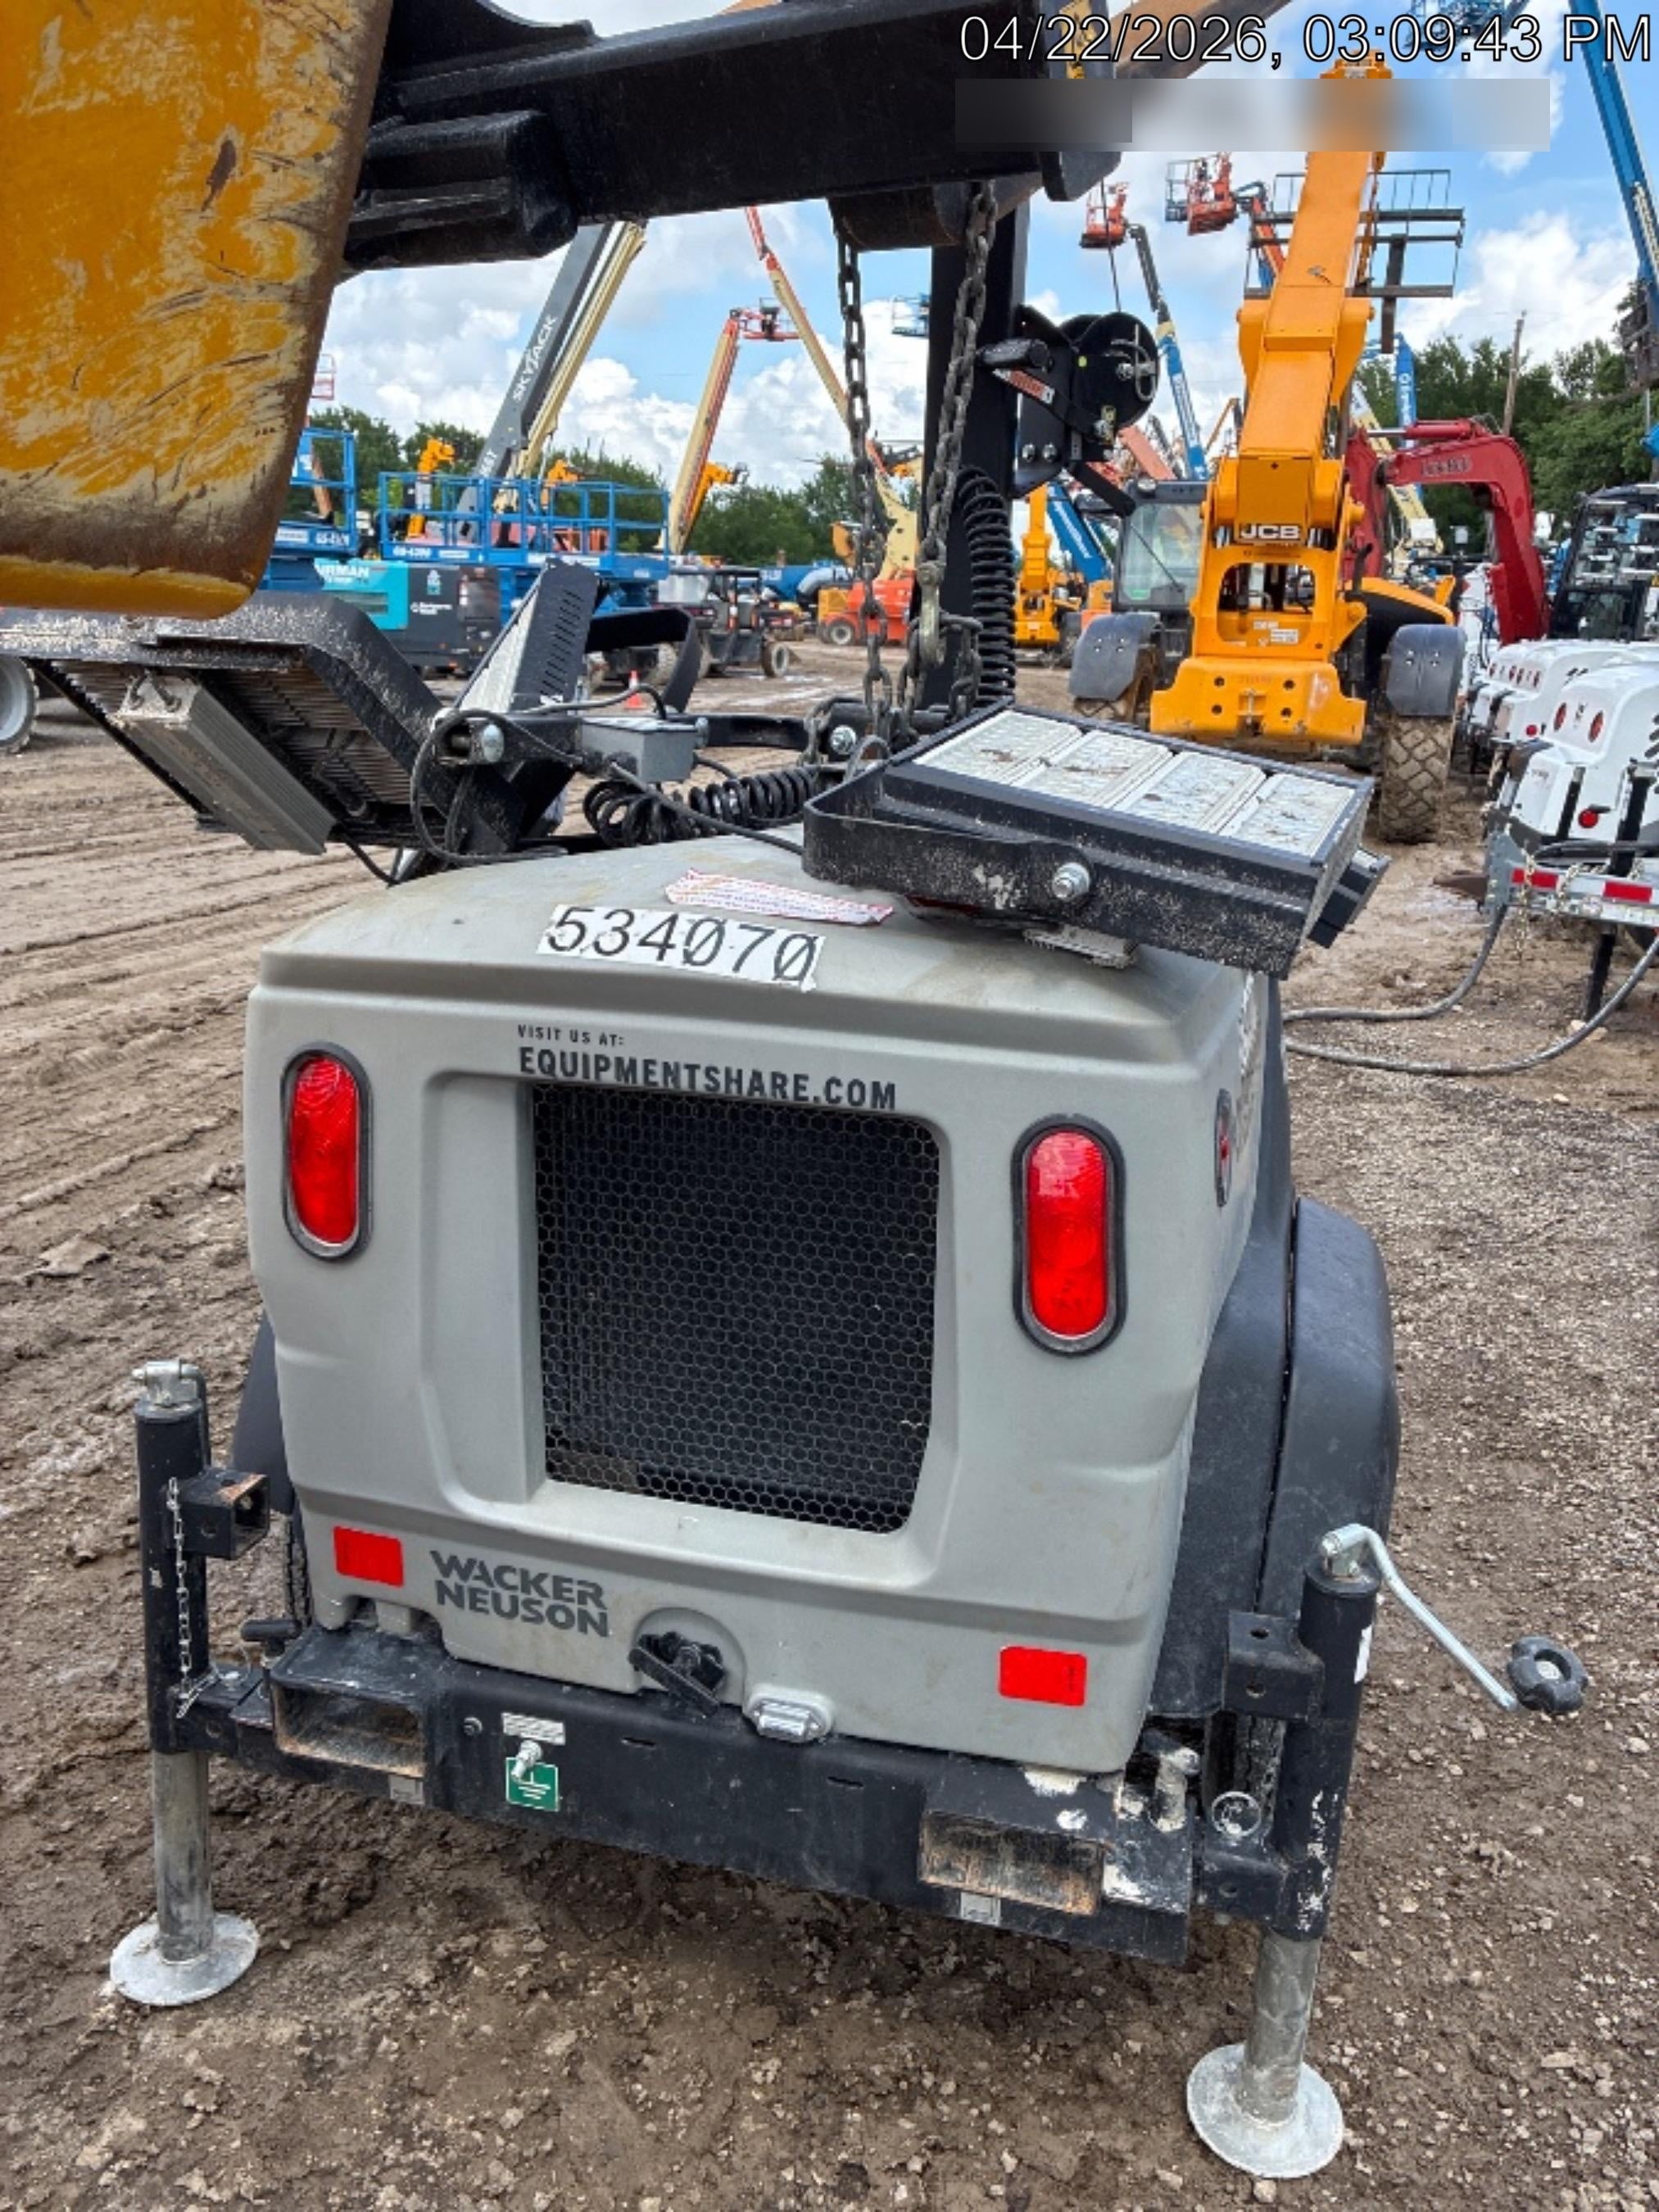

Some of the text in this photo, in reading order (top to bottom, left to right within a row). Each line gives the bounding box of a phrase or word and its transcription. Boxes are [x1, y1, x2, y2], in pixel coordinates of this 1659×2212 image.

[513, 314, 557, 401] SKYJACK
[1241, 524, 1299, 539] JCB
[547, 906, 819, 981] 534070
[518, 1024, 624, 1046] VISIT US AT:
[519, 1046, 896, 1109] EQUIPMENTSHARE.COM
[430, 1550, 609, 1611] WACKER
[435, 1580, 610, 1638] NEUSON
